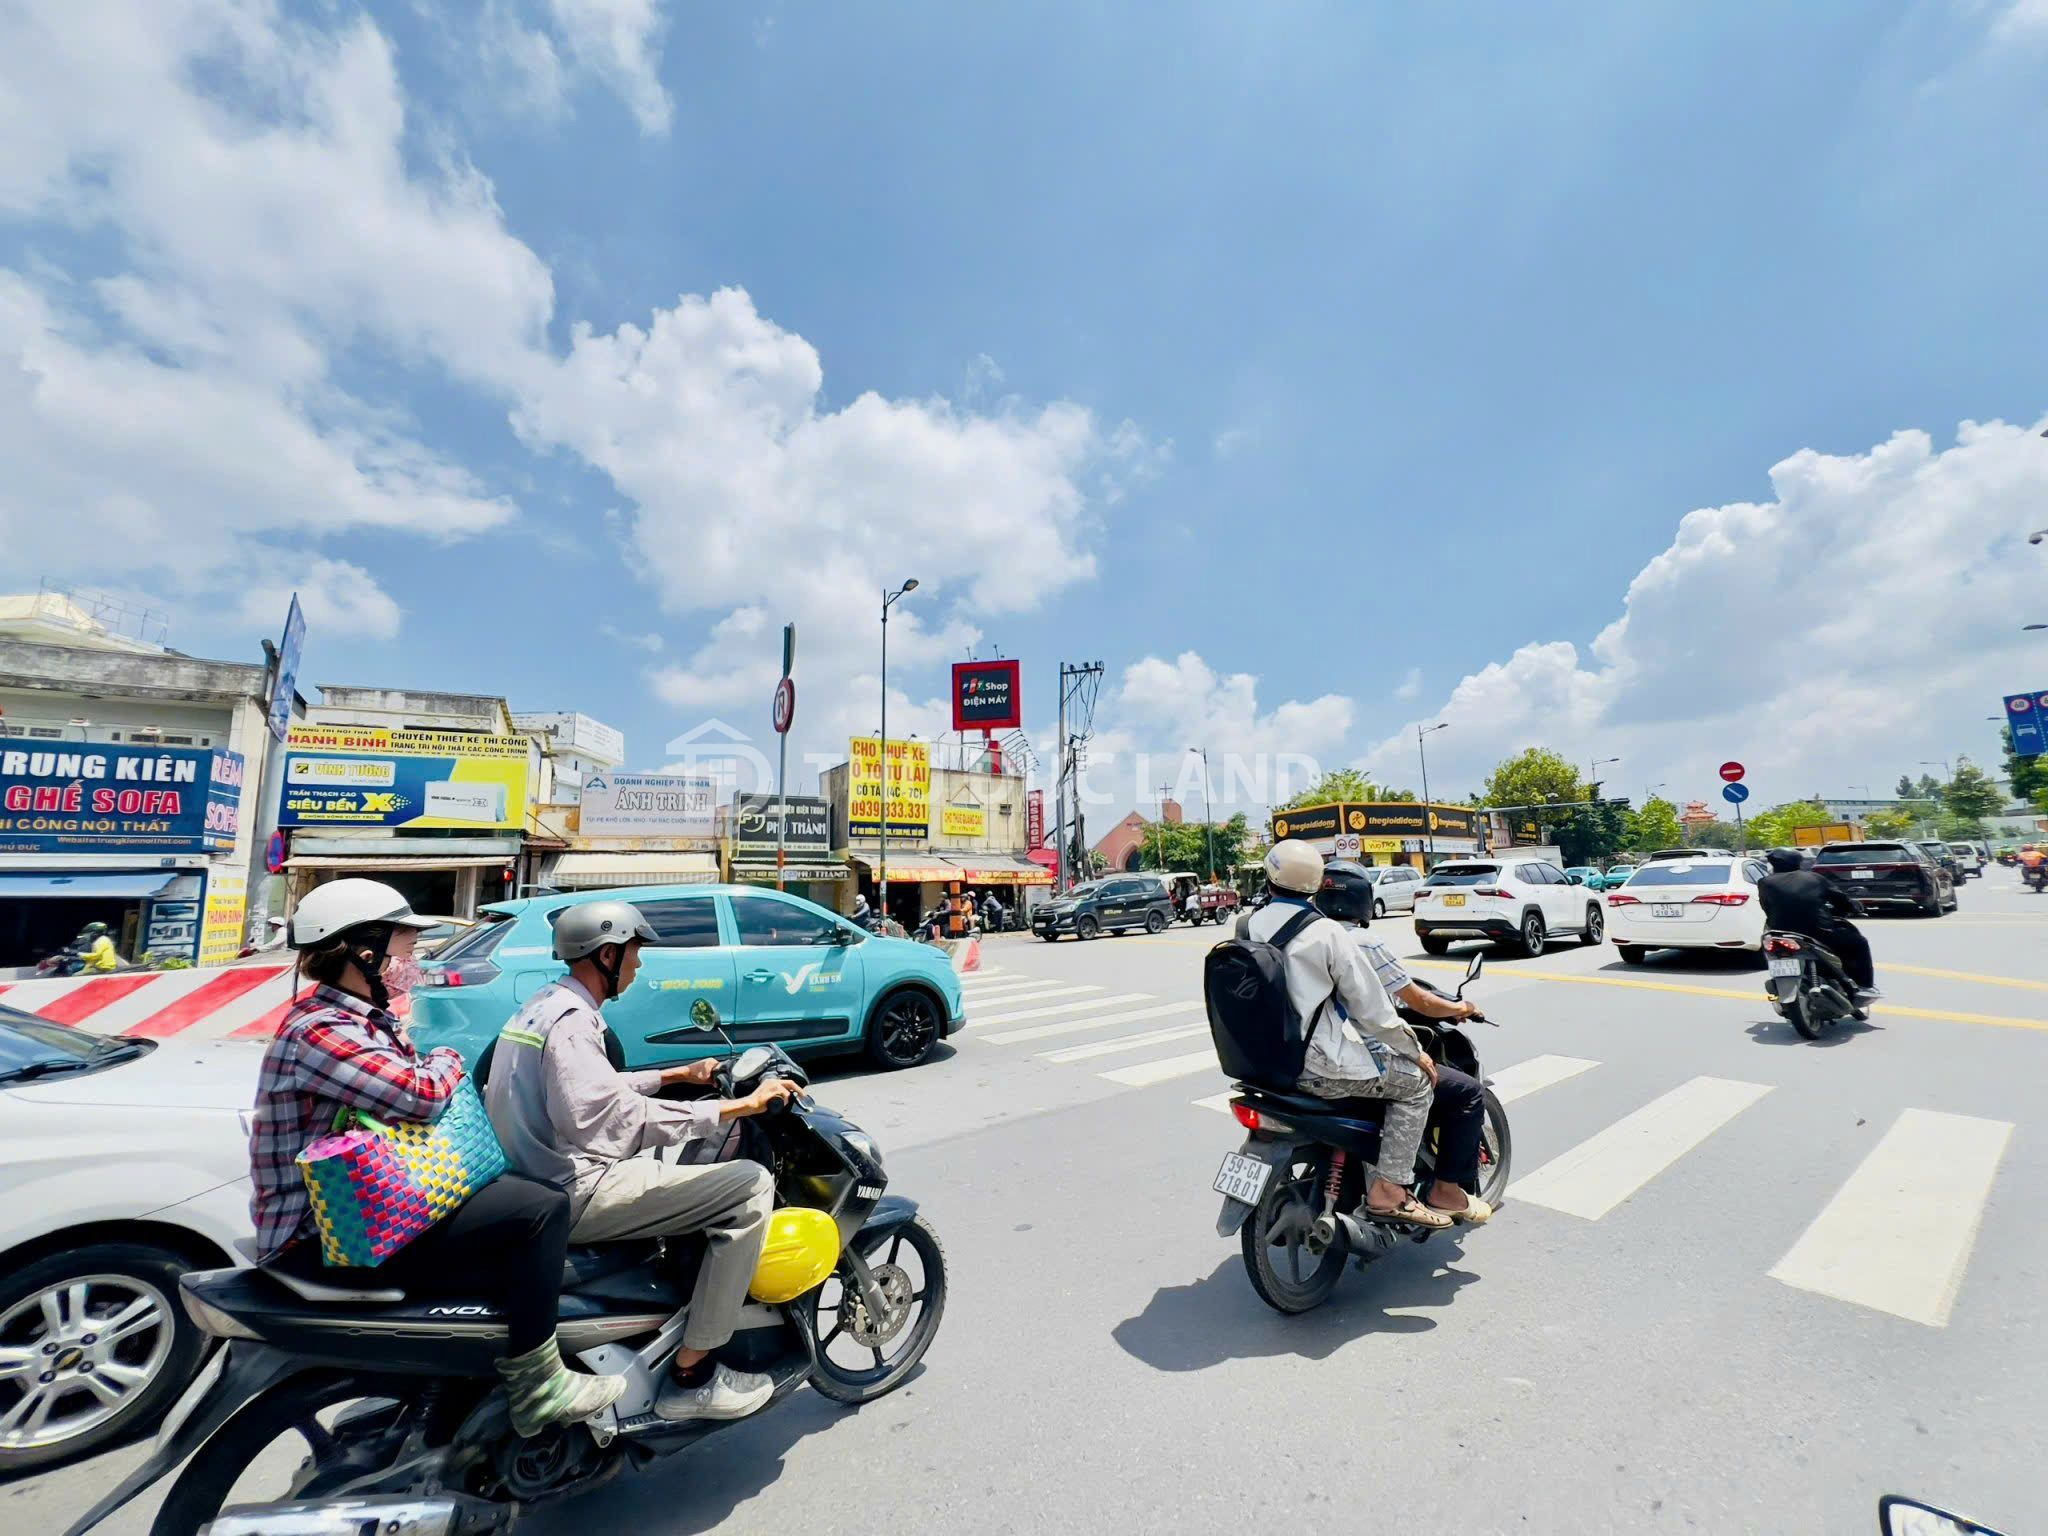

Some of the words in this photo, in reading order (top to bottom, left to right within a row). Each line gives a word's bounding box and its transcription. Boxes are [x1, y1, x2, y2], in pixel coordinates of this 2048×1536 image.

[986, 682, 1008, 691] Shop
[963, 696, 986, 707] ĐIỆN
[988, 695, 1007, 704] MÁY
[483, 736, 498, 744] THI
[853, 741, 876, 757] CHO
[880, 742, 907, 760] HUÊ
[115, 754, 196, 782] KIÊN
[853, 759, 861, 778] Ô
[866, 761, 881, 779] TÔ
[906, 764, 926, 782] LÁI
[5, 779, 83, 812] GHẾ
[92, 788, 181, 814] SOFA
[615, 786, 653, 811] ÁNH
[856, 783, 868, 796] CÓ
[871, 784, 881, 797] TÀ
[287, 798, 322, 810] SIÊU
[852, 800, 926, 818] 0939333.331
[16, 816, 77, 832] CÔNG
[82, 820, 117, 833] NỘI
[121, 818, 171, 832] THẤT
[205, 801, 241, 832] SOFA
[1028, 792, 1040, 844] MASSAGE
[1289, 818, 1336, 832] thegioididong
[1368, 816, 1424, 828] thegioididong
[792, 819, 826, 835] THÀNH
[1217, 1173, 1258, 1201] 218.01
